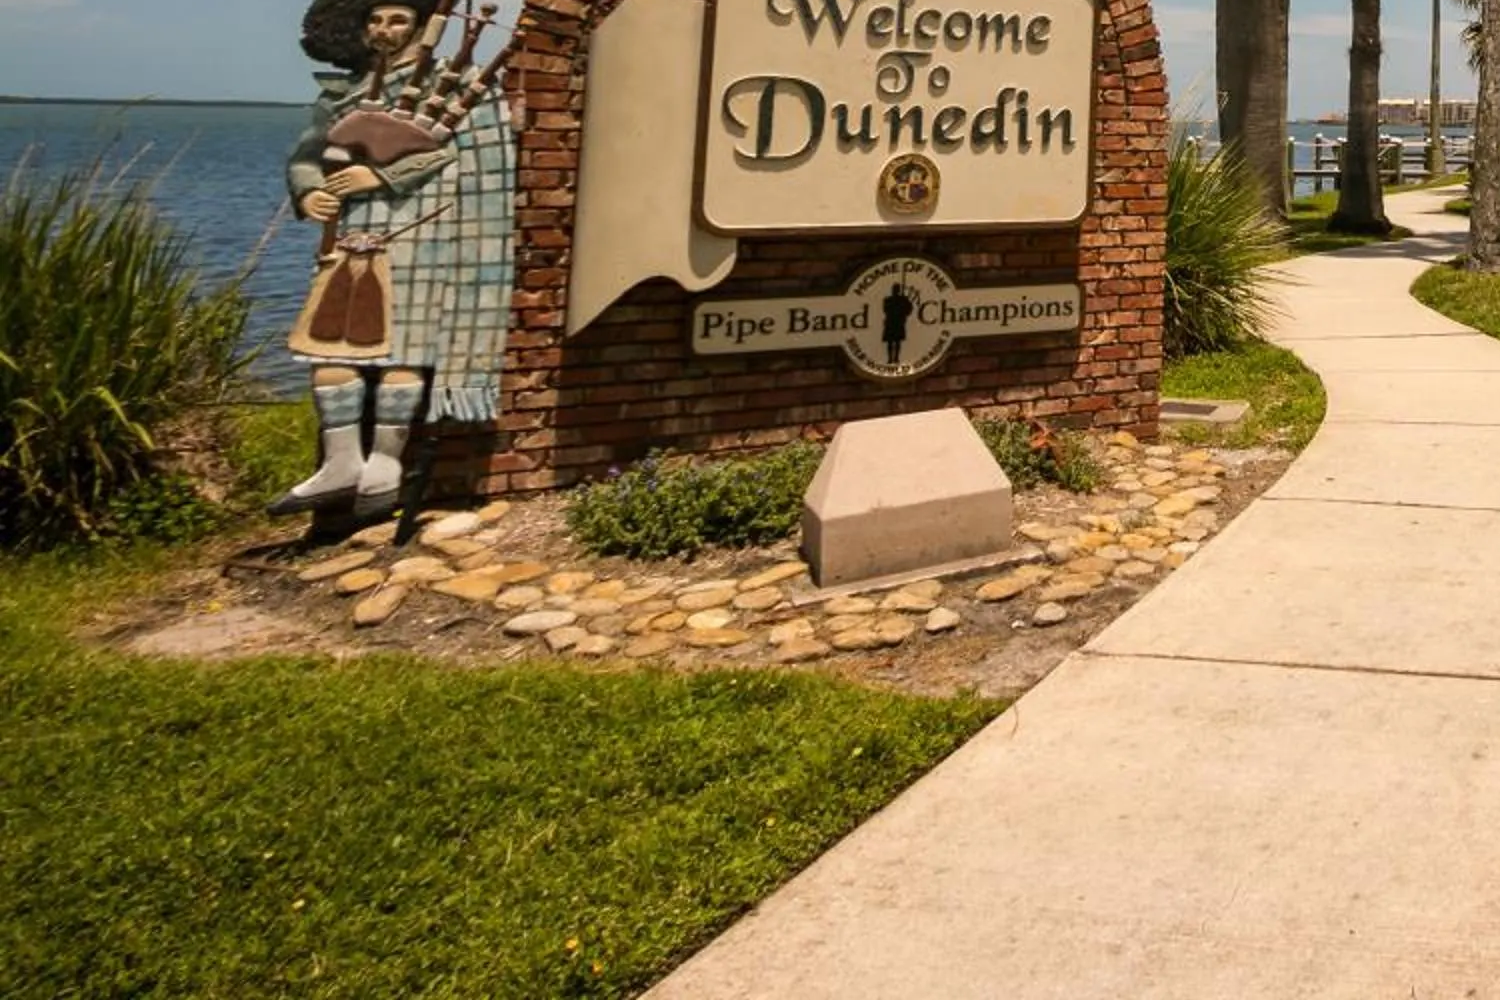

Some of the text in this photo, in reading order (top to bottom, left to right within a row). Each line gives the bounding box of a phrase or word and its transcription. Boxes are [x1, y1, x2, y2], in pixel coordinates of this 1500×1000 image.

[876, 50, 951, 97] To
[722, 74, 1076, 164] Dunedin
[853, 261, 949, 295] HOME OF THE
[700, 296, 1073, 343] Pipe Band Champions
